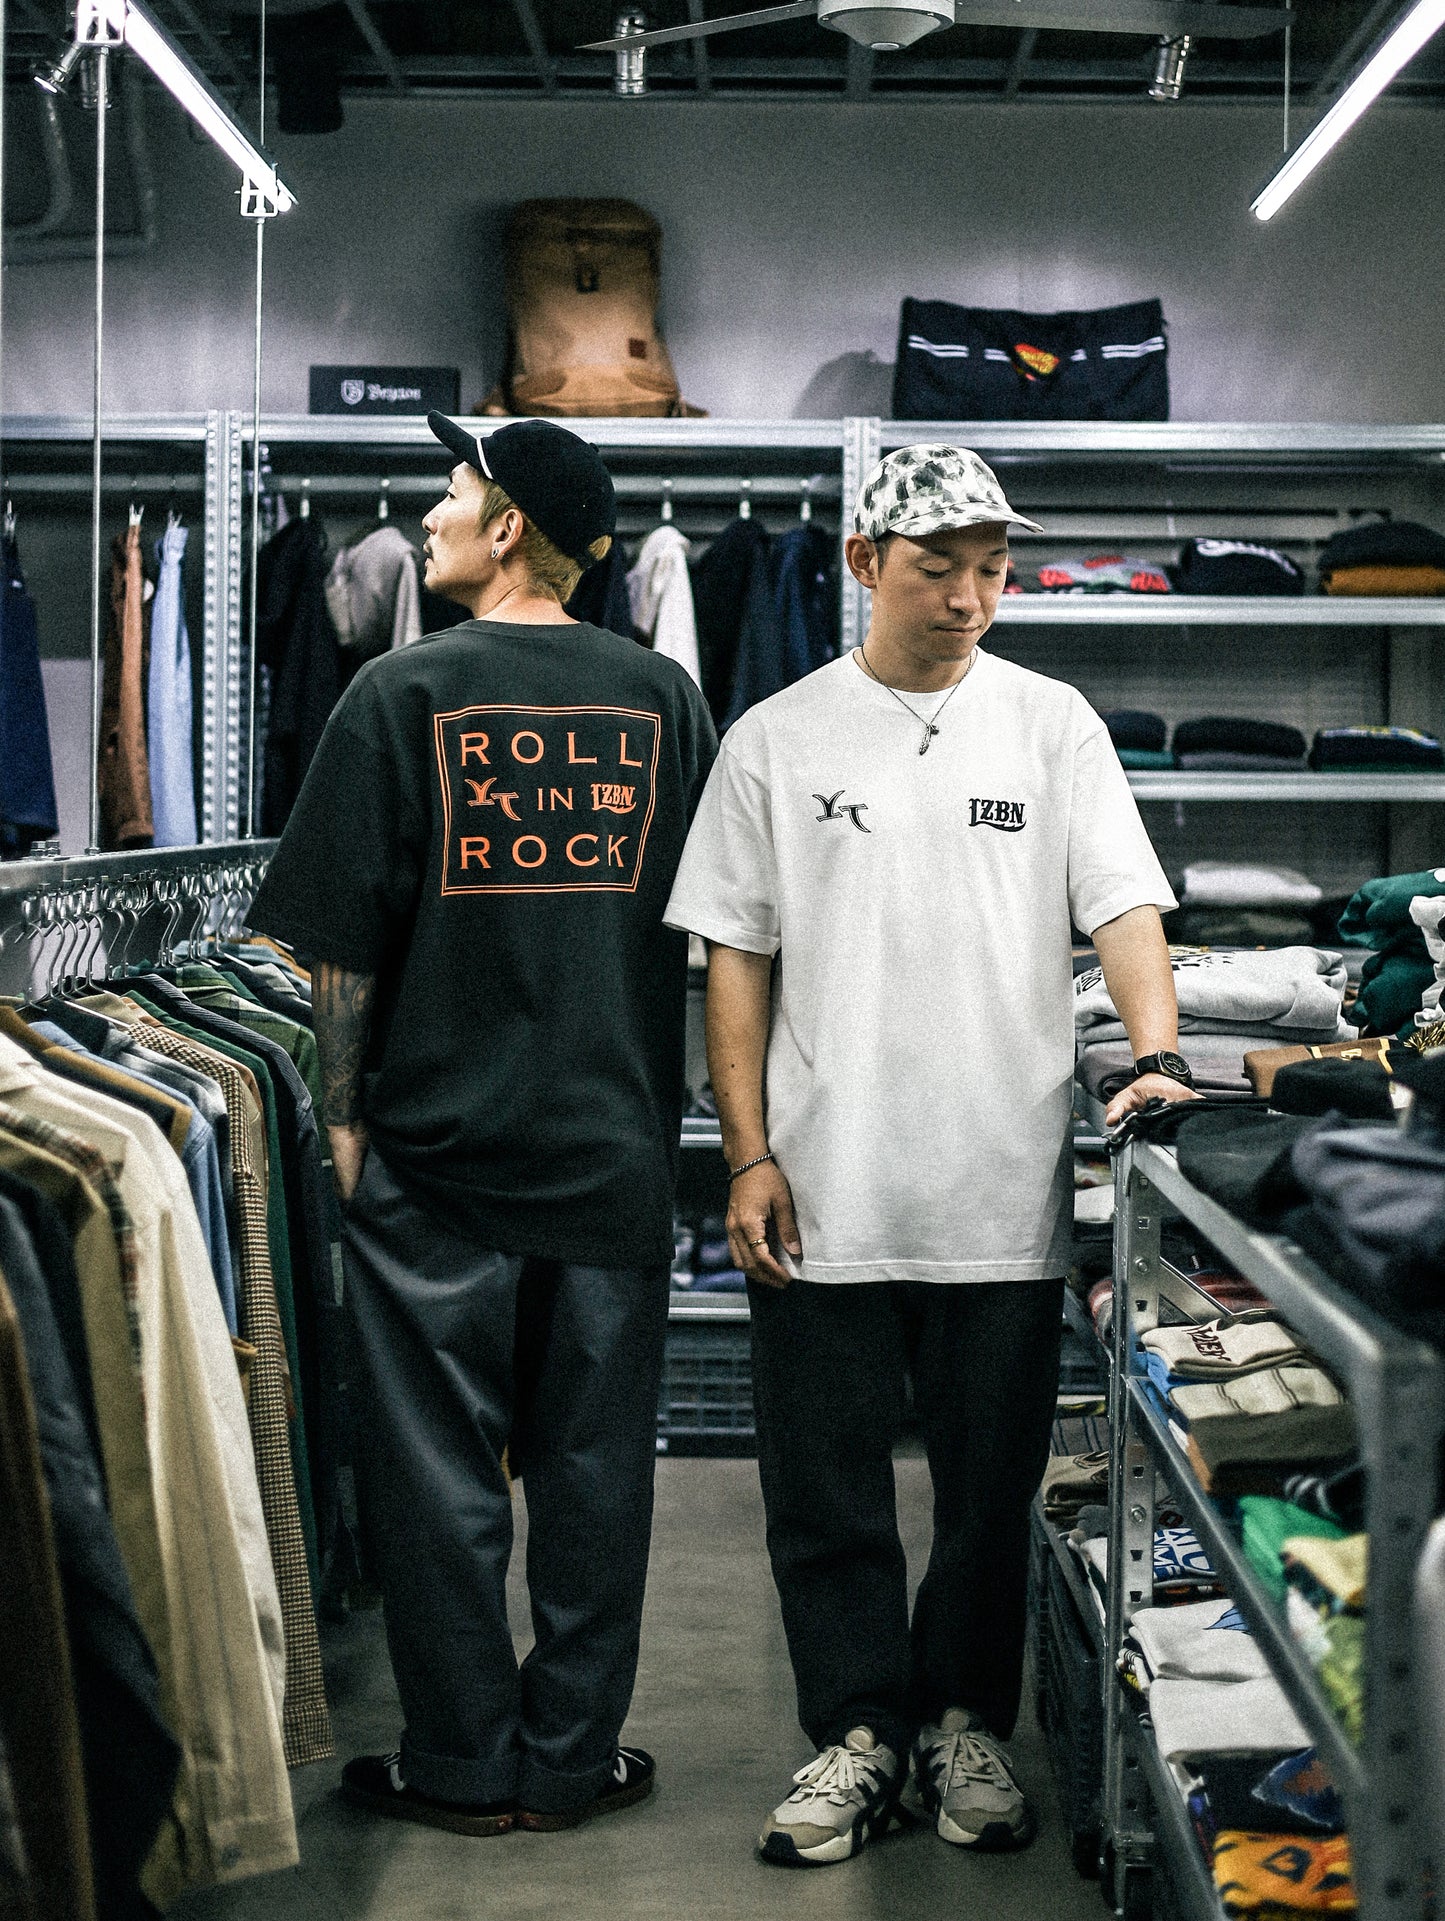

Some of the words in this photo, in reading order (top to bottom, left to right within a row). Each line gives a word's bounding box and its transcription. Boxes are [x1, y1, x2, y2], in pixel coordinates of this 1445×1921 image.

[459, 730, 643, 768] ROLL
[537, 787, 574, 811] IN
[459, 833, 629, 870] ROCK
